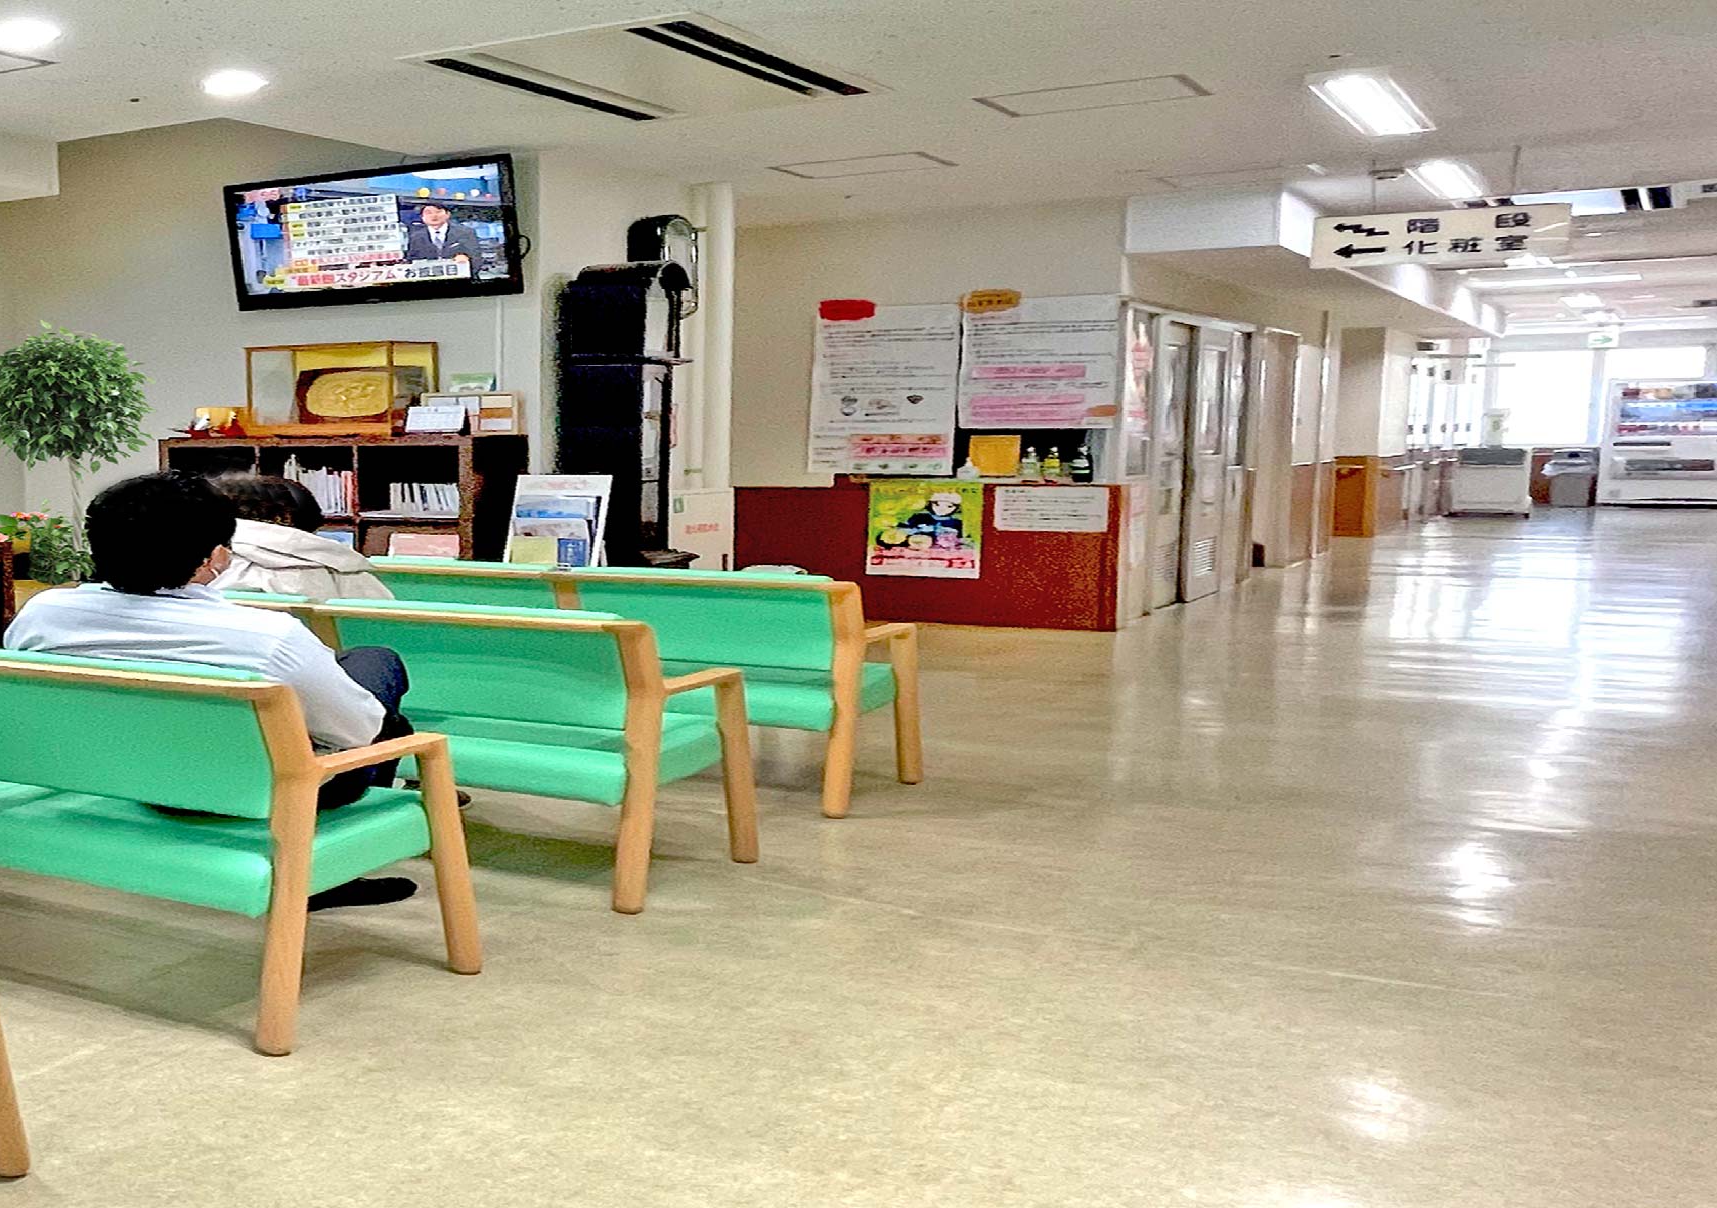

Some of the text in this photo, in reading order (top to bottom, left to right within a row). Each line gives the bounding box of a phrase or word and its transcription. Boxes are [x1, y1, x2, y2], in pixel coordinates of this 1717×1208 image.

[1407, 212, 1532, 233] 階段
[1403, 234, 1529, 255] 化粧室
